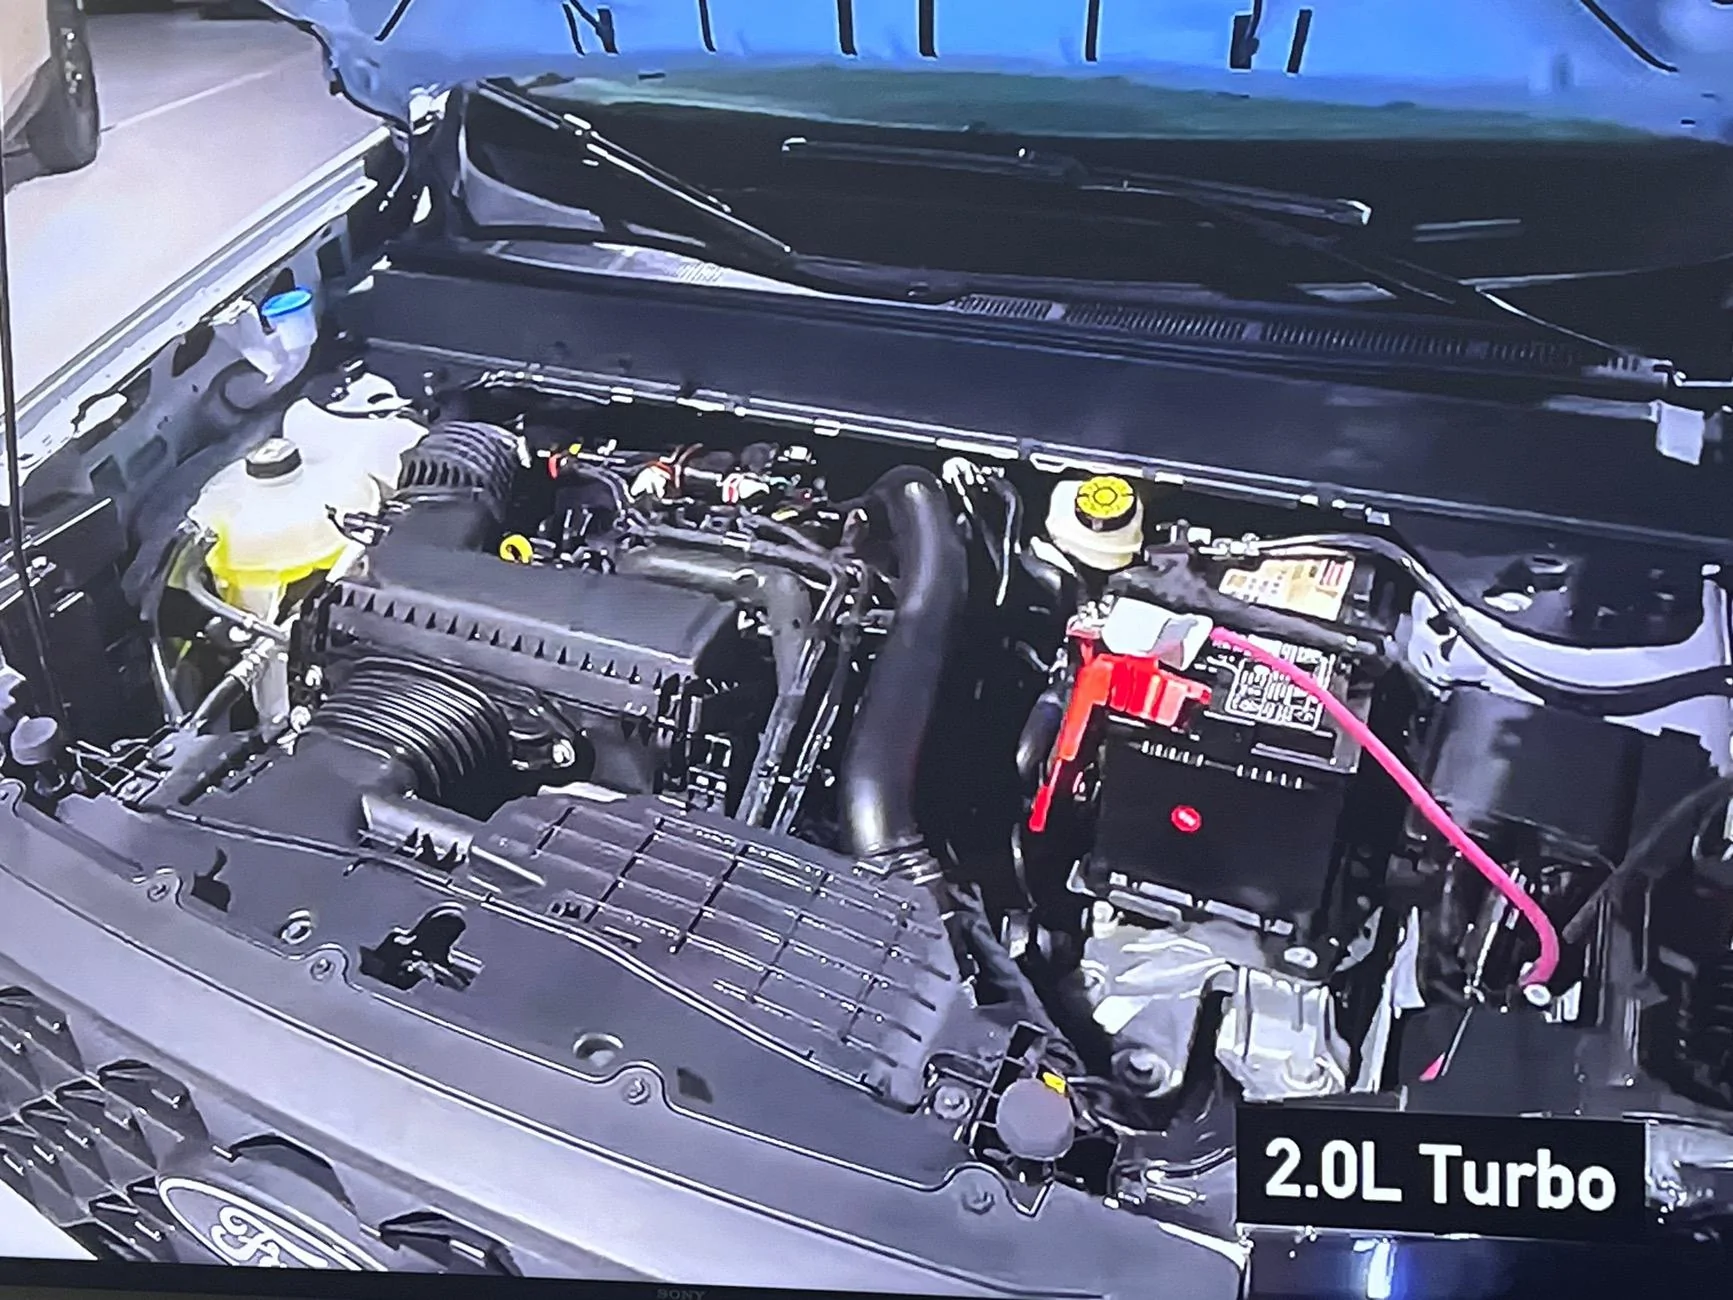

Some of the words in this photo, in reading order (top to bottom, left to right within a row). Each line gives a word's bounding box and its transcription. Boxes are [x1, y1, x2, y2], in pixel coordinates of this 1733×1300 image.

[1265, 1137, 1402, 1202] 2.0L
[1419, 1143, 1616, 1212] Turbo
[656, 1288, 706, 1300] SONY
